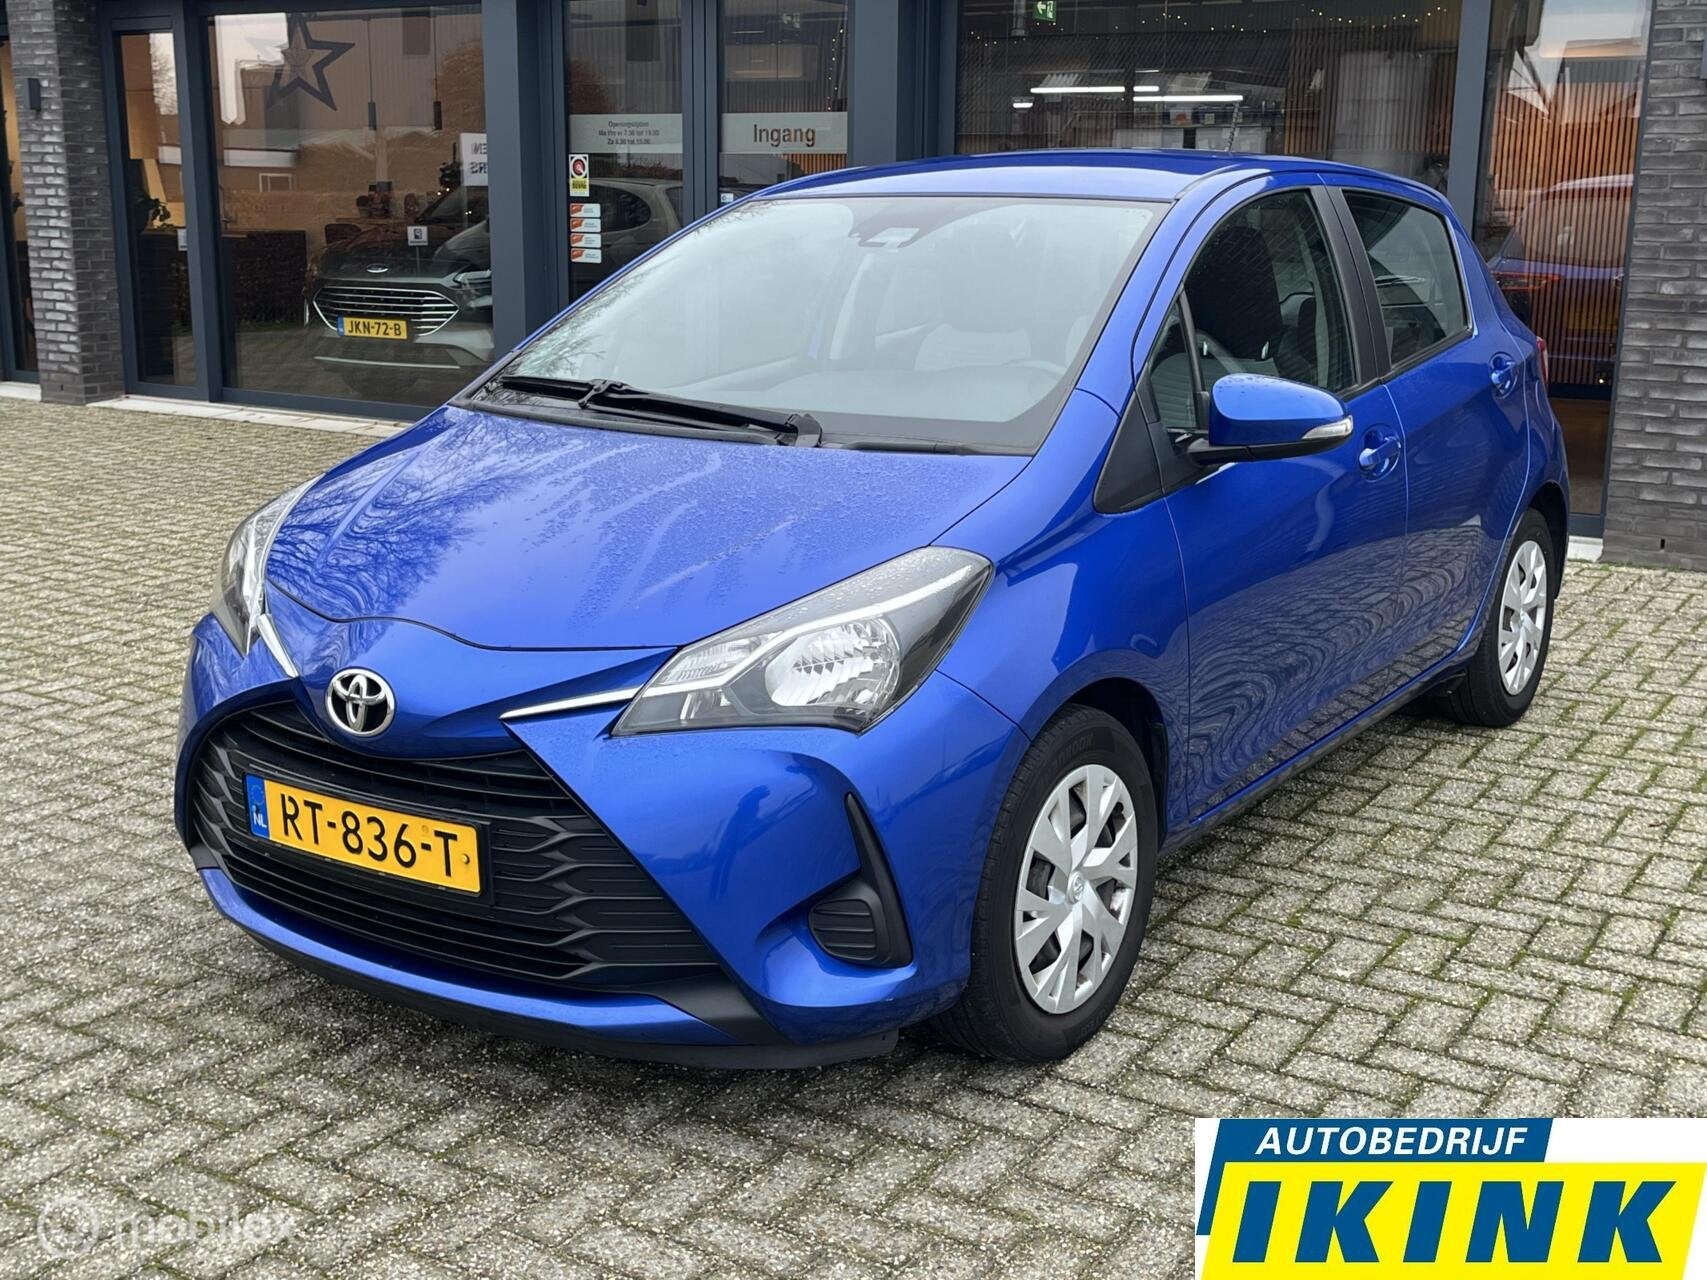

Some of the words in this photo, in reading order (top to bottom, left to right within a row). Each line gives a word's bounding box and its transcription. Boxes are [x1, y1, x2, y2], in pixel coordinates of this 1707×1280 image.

[754, 123, 816, 148] Ingang
[348, 320, 402, 336] JKN-72-B
[252, 811, 268, 829] NL
[280, 793, 458, 878] RT-836-T
